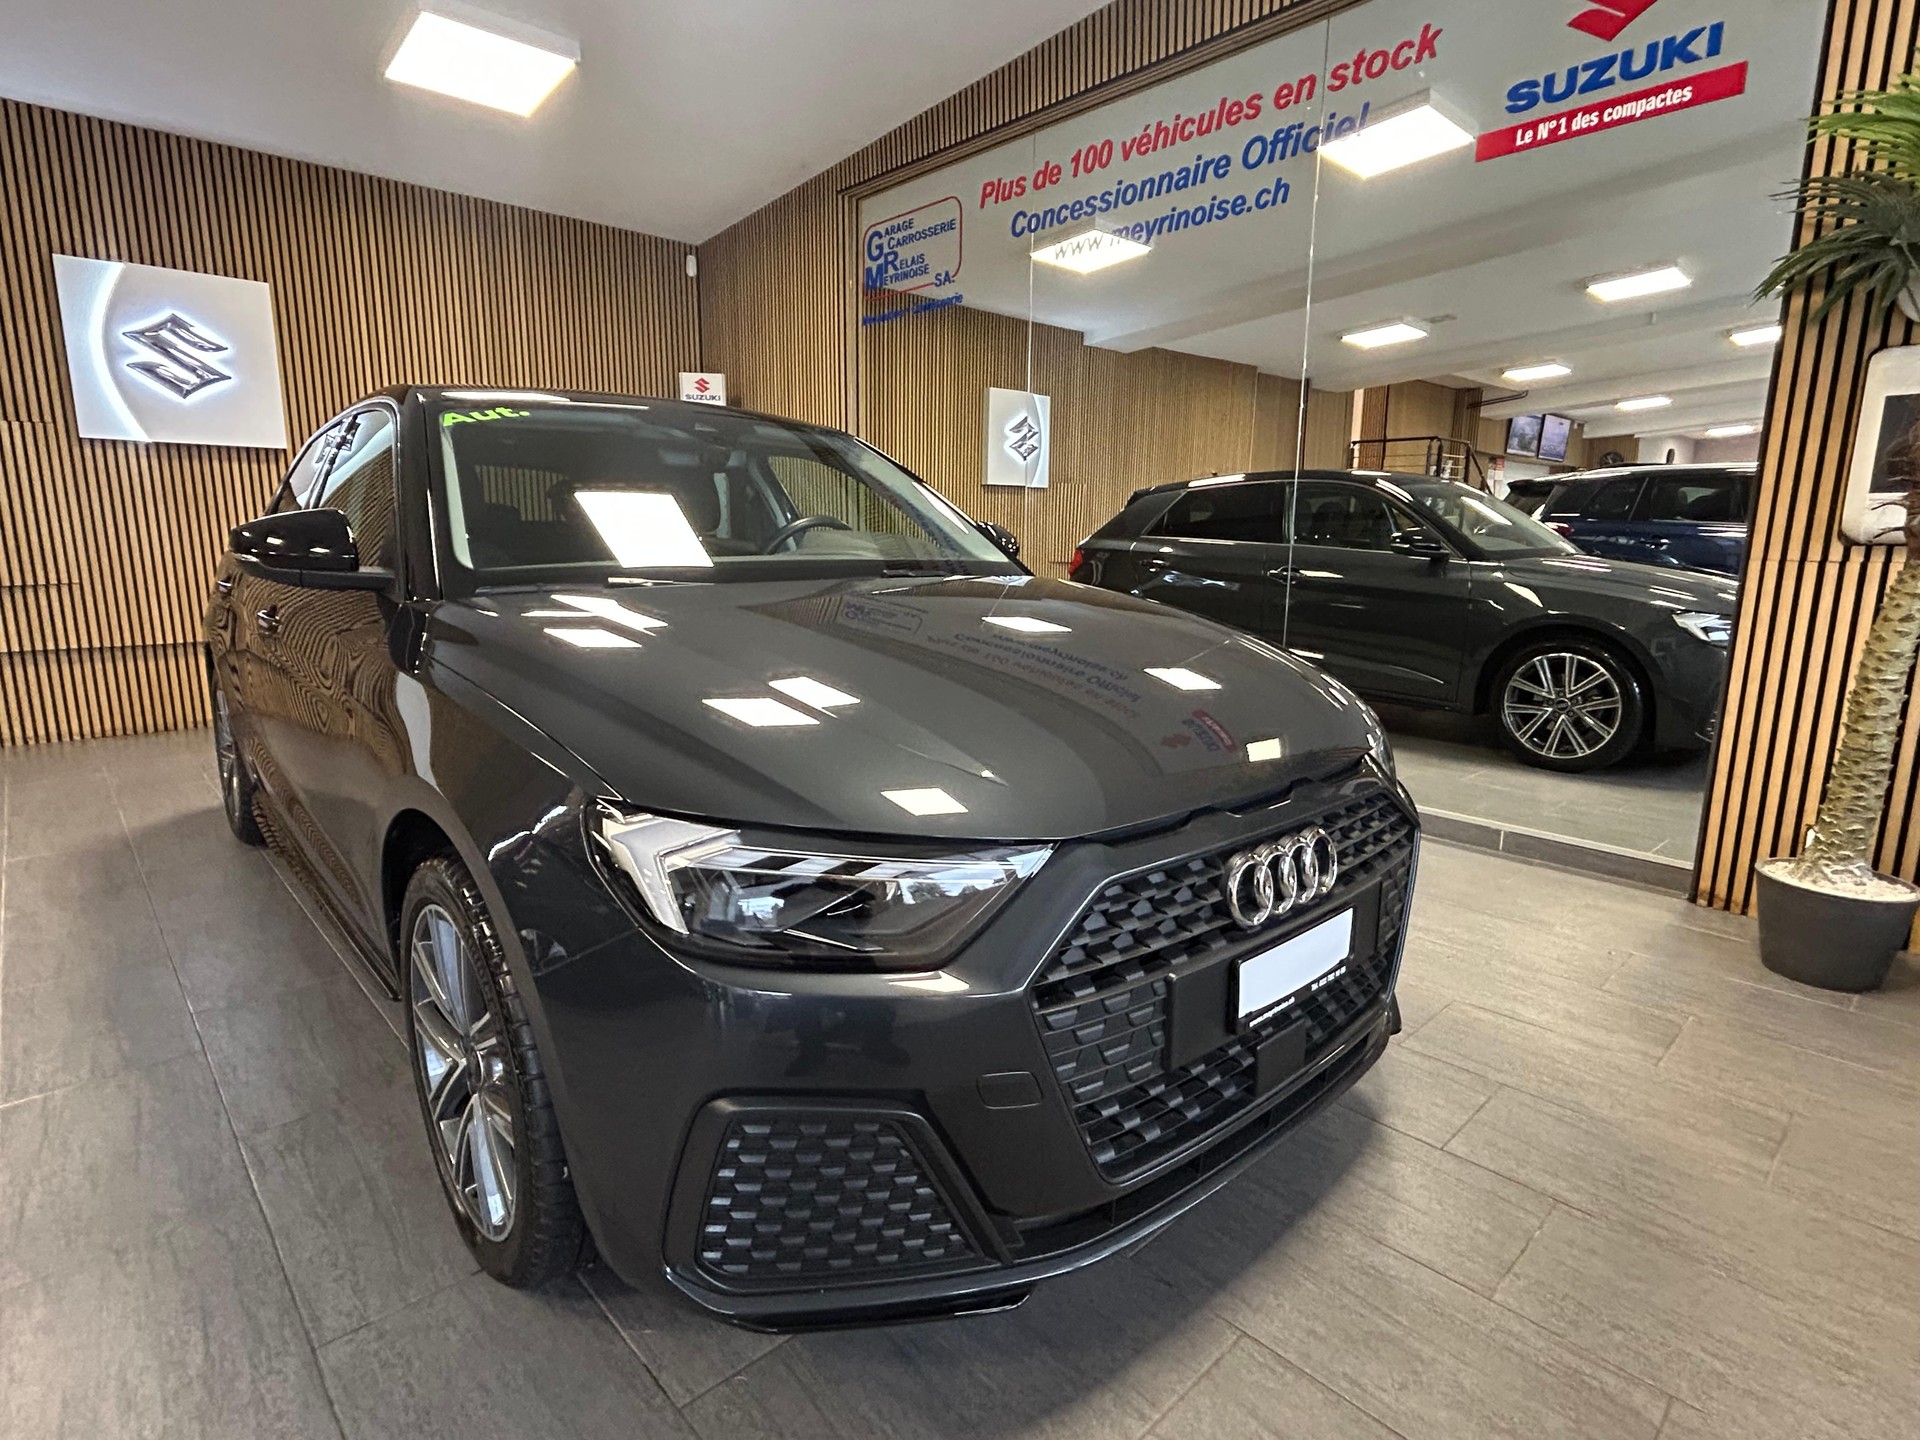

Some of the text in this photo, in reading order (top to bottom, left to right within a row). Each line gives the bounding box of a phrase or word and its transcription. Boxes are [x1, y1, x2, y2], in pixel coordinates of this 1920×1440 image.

[1505, 21, 1725, 114] SUZUKI
[980, 23, 1443, 209] Plus de 100 véhicules en stock
[1515, 128, 1534, 147] Le
[1571, 111, 1599, 131] des
[1603, 85, 1693, 123] compactes
[1010, 101, 1370, 238] Concessionnaire Officiel
[867, 218, 915, 262] GARAGE
[887, 218, 957, 250] CARROSSERIE
[1055, 177, 1290, 260] wwwmeyrinoise.ch
[865, 263, 930, 291] MEYRINOISE
[883, 250, 926, 275] RELAIS
[443, 407, 530, 427] Aut.
[685, 393, 721, 401] SUZUKI
